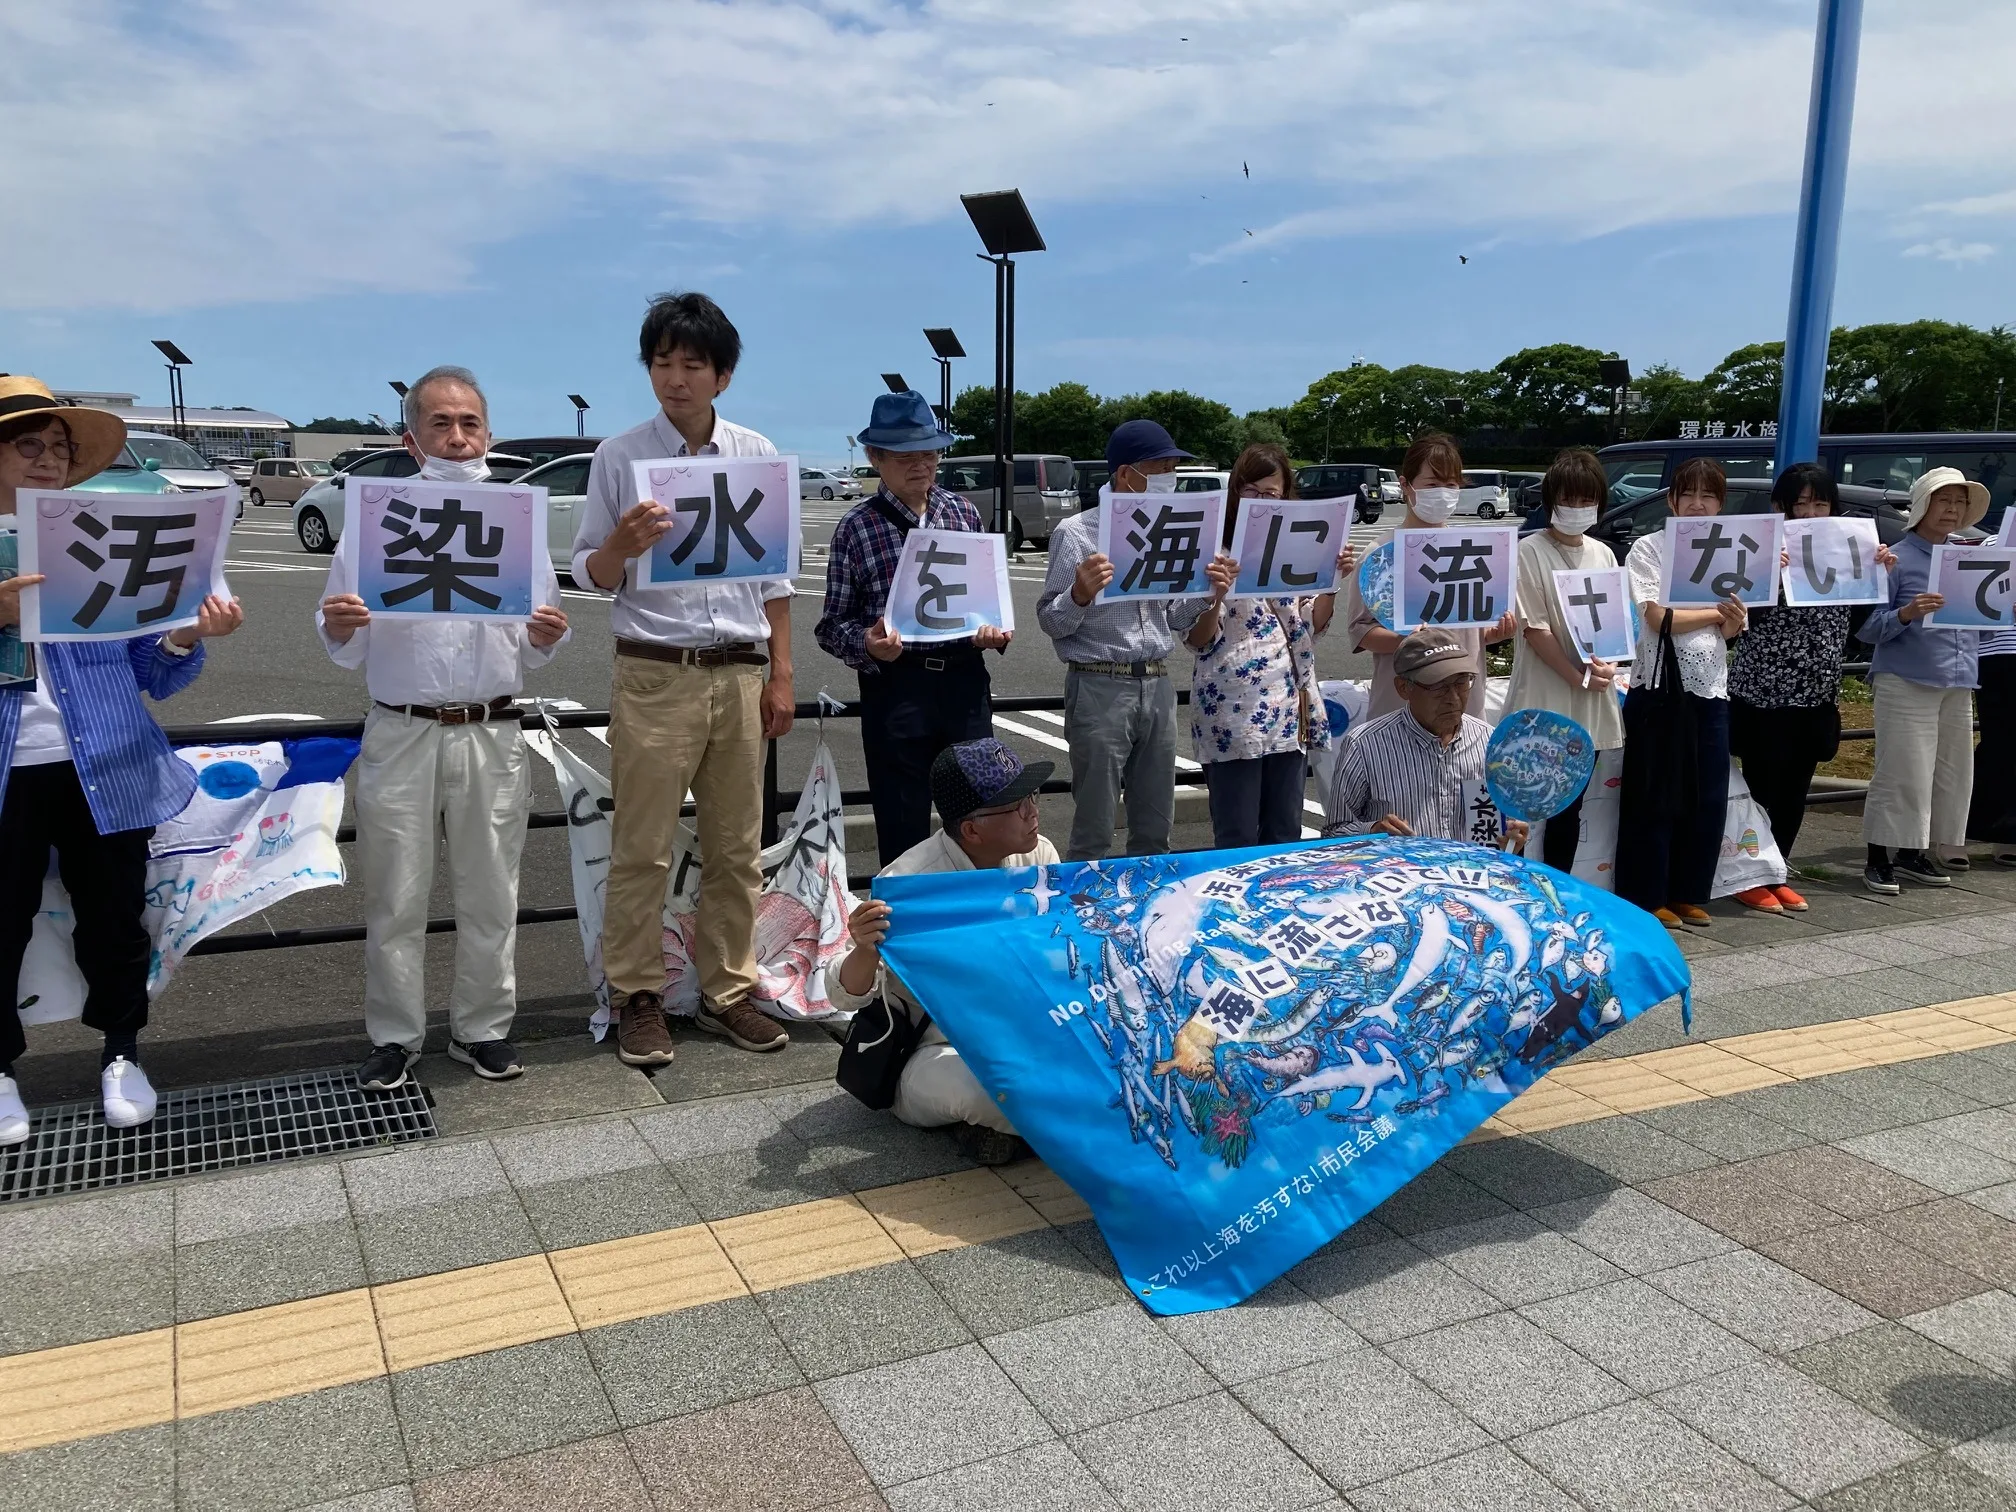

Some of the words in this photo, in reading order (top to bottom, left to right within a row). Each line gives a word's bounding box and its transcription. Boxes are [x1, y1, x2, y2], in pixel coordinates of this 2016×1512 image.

[379, 497, 505, 613] 染
[668, 472, 766, 577] 水
[1119, 505, 1205, 595] 海
[1257, 514, 1329, 587] に
[1691, 522, 1760, 593] な
[65, 510, 197, 630] 汚
[914, 539, 968, 630] を
[1418, 538, 1494, 623] 流
[1801, 535, 1861, 596] い
[1957, 560, 2011, 621] で
[1423, 643, 1461, 657] DUNE
[1568, 577, 1608, 653] さ
[215, 749, 260, 759] STOP
[1470, 785, 1500, 847] 染水
[1048, 1000, 1084, 1026] No
[1088, 939, 1192, 1002] Dumping
